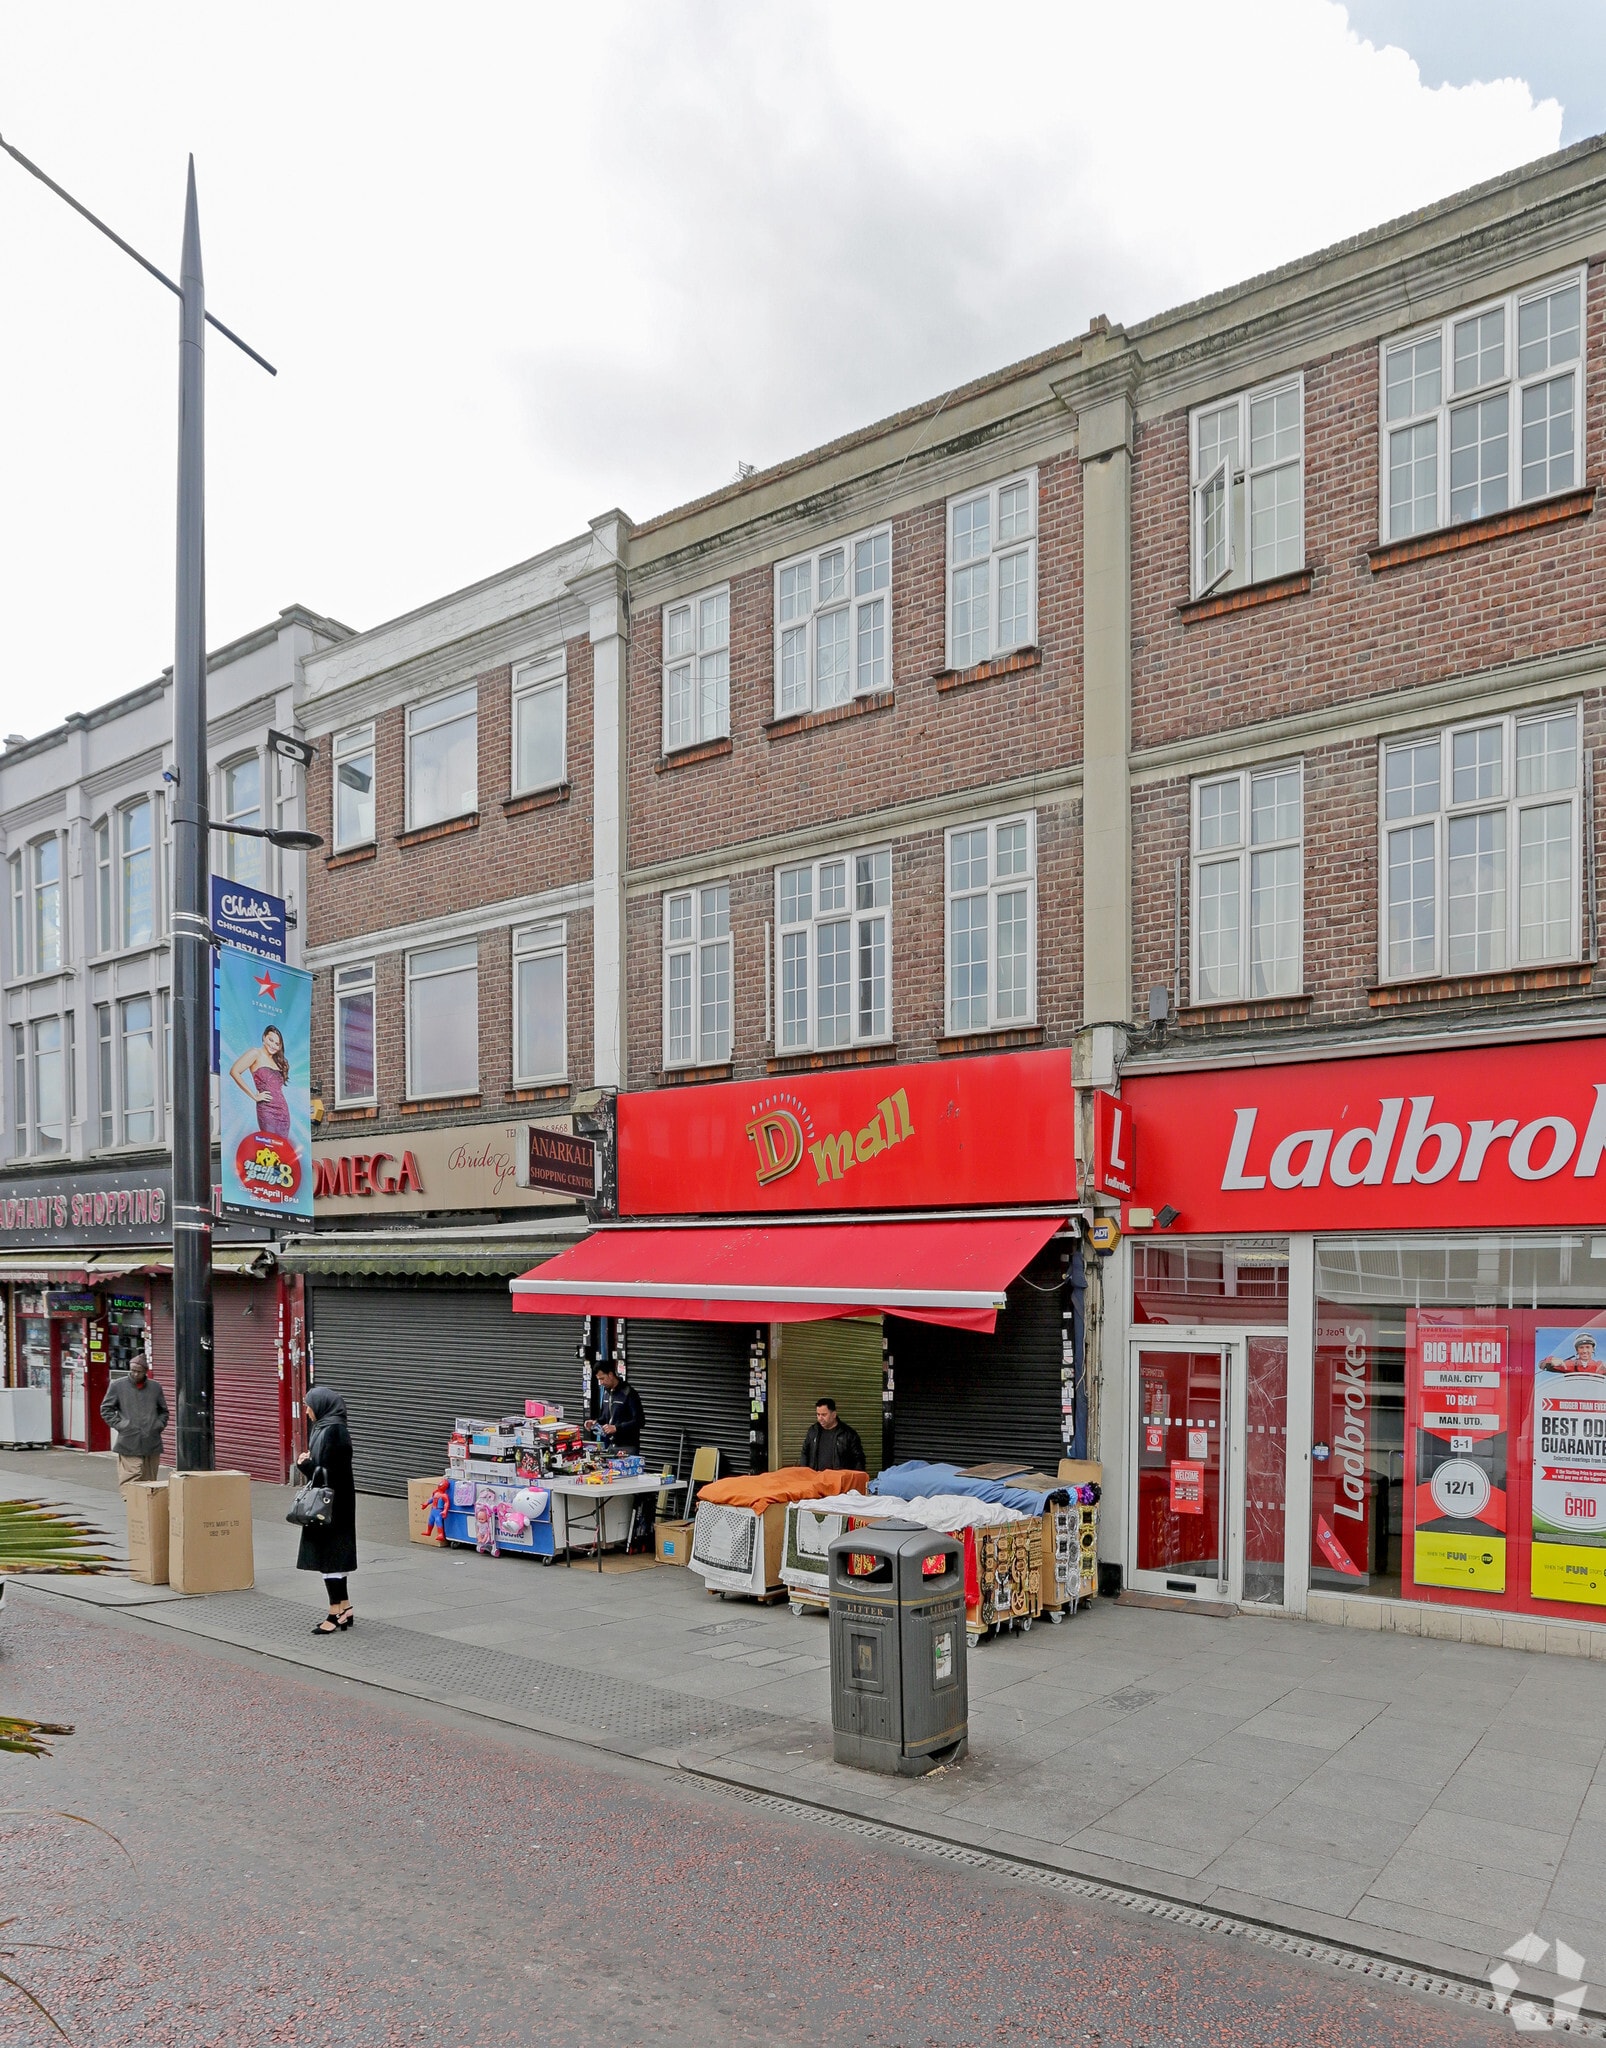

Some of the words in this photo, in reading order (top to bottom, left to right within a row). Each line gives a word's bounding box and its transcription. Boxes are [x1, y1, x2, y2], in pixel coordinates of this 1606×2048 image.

[217, 919, 260, 939] CHHOKAR
[268, 937, 282, 947] CO
[252, 1000, 267, 1009] STAR
[268, 1004, 283, 1014] PLUS
[745, 1109, 803, 1187] D
[808, 1087, 915, 1186] mall
[1110, 1107, 1126, 1171] L
[448, 1142, 494, 1171] Bride
[531, 1136, 594, 1168] ANARKALI
[279, 1164, 294, 1188] 8
[530, 1165, 567, 1185] SHOPPING
[567, 1173, 594, 1189] CENTRE
[1105, 1173, 1131, 1194] Ladbrokes
[263, 1188, 281, 1198] April
[283, 1195, 299, 1204] 8PM
[71, 1187, 166, 1227] SHOPPING
[1094, 1227, 1109, 1238] ADT
[1423, 1342, 1447, 1363] BIG
[1450, 1342, 1501, 1364] MATCH
[1440, 1374, 1462, 1383] MAN.
[1464, 1374, 1484, 1383] CITY
[1446, 1394, 1456, 1405] TO
[1457, 1394, 1478, 1406] BEAT
[1334, 1325, 1367, 1522] Ladbrokes
[1439, 1415, 1462, 1426] MAN.
[1464, 1415, 1483, 1426] UTD.
[1541, 1416, 1579, 1437] BEST
[1583, 1418, 1606, 1438] OD
[1453, 1438, 1470, 1450] 3-1
[1175, 1470, 1199, 1482] WELCOME
[1444, 1480, 1475, 1496] 12/1
[1564, 1497, 1597, 1518] GRID
[1446, 1551, 1467, 1561] FUN
[1565, 1564, 1588, 1576] FUN
[847, 1603, 884, 1617] LITTER
